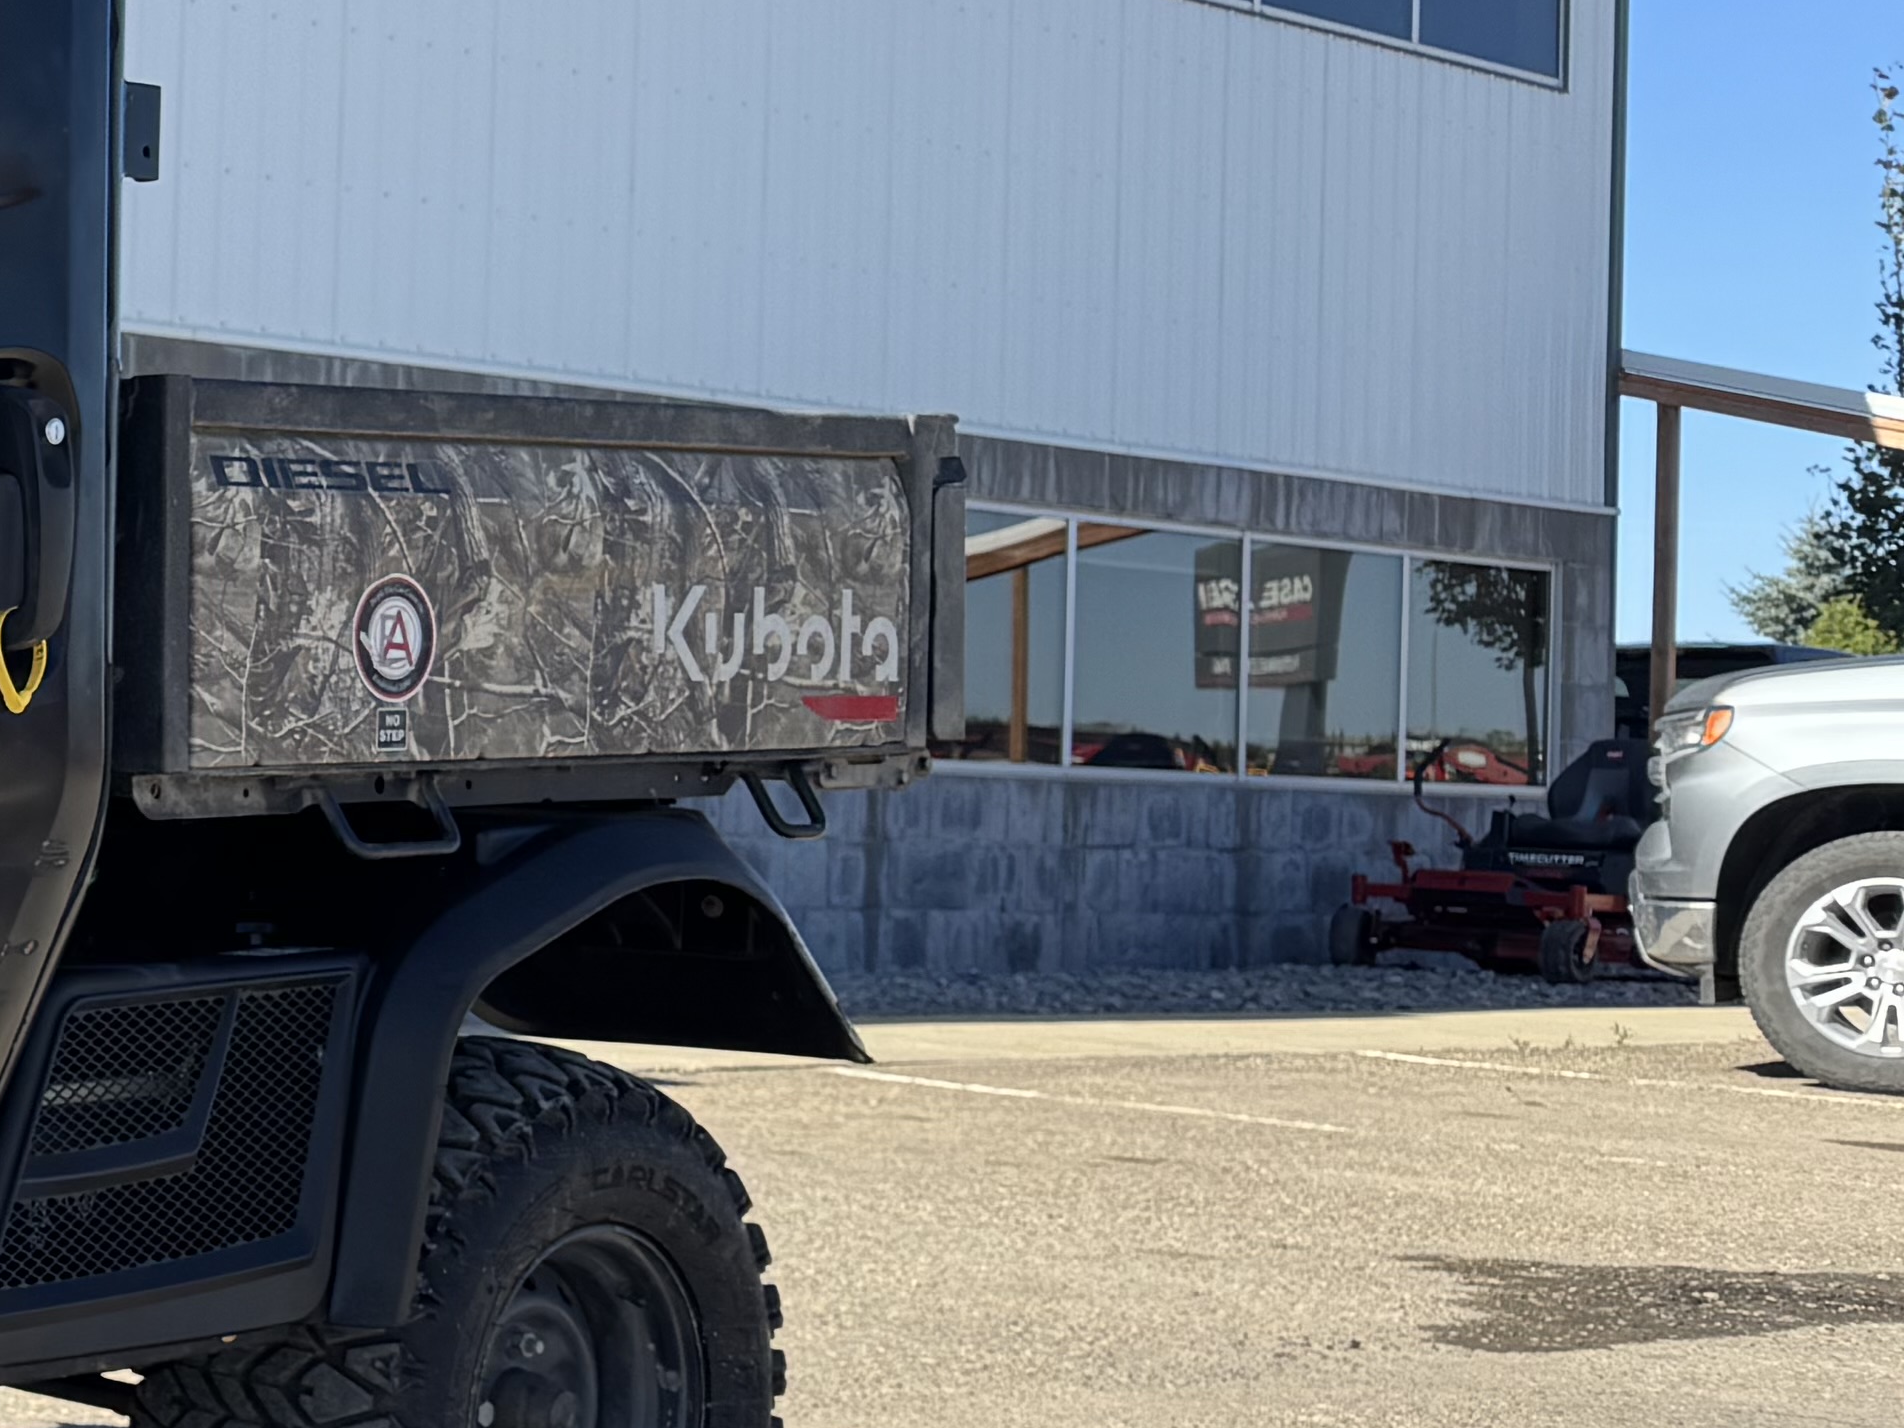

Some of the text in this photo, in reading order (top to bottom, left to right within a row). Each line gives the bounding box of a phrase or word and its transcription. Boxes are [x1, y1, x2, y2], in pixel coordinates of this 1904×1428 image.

[209, 455, 451, 493] DIESEL
[642, 582, 899, 683] Kubota
[385, 714, 400, 727] NO
[379, 729, 404, 742] STEP
